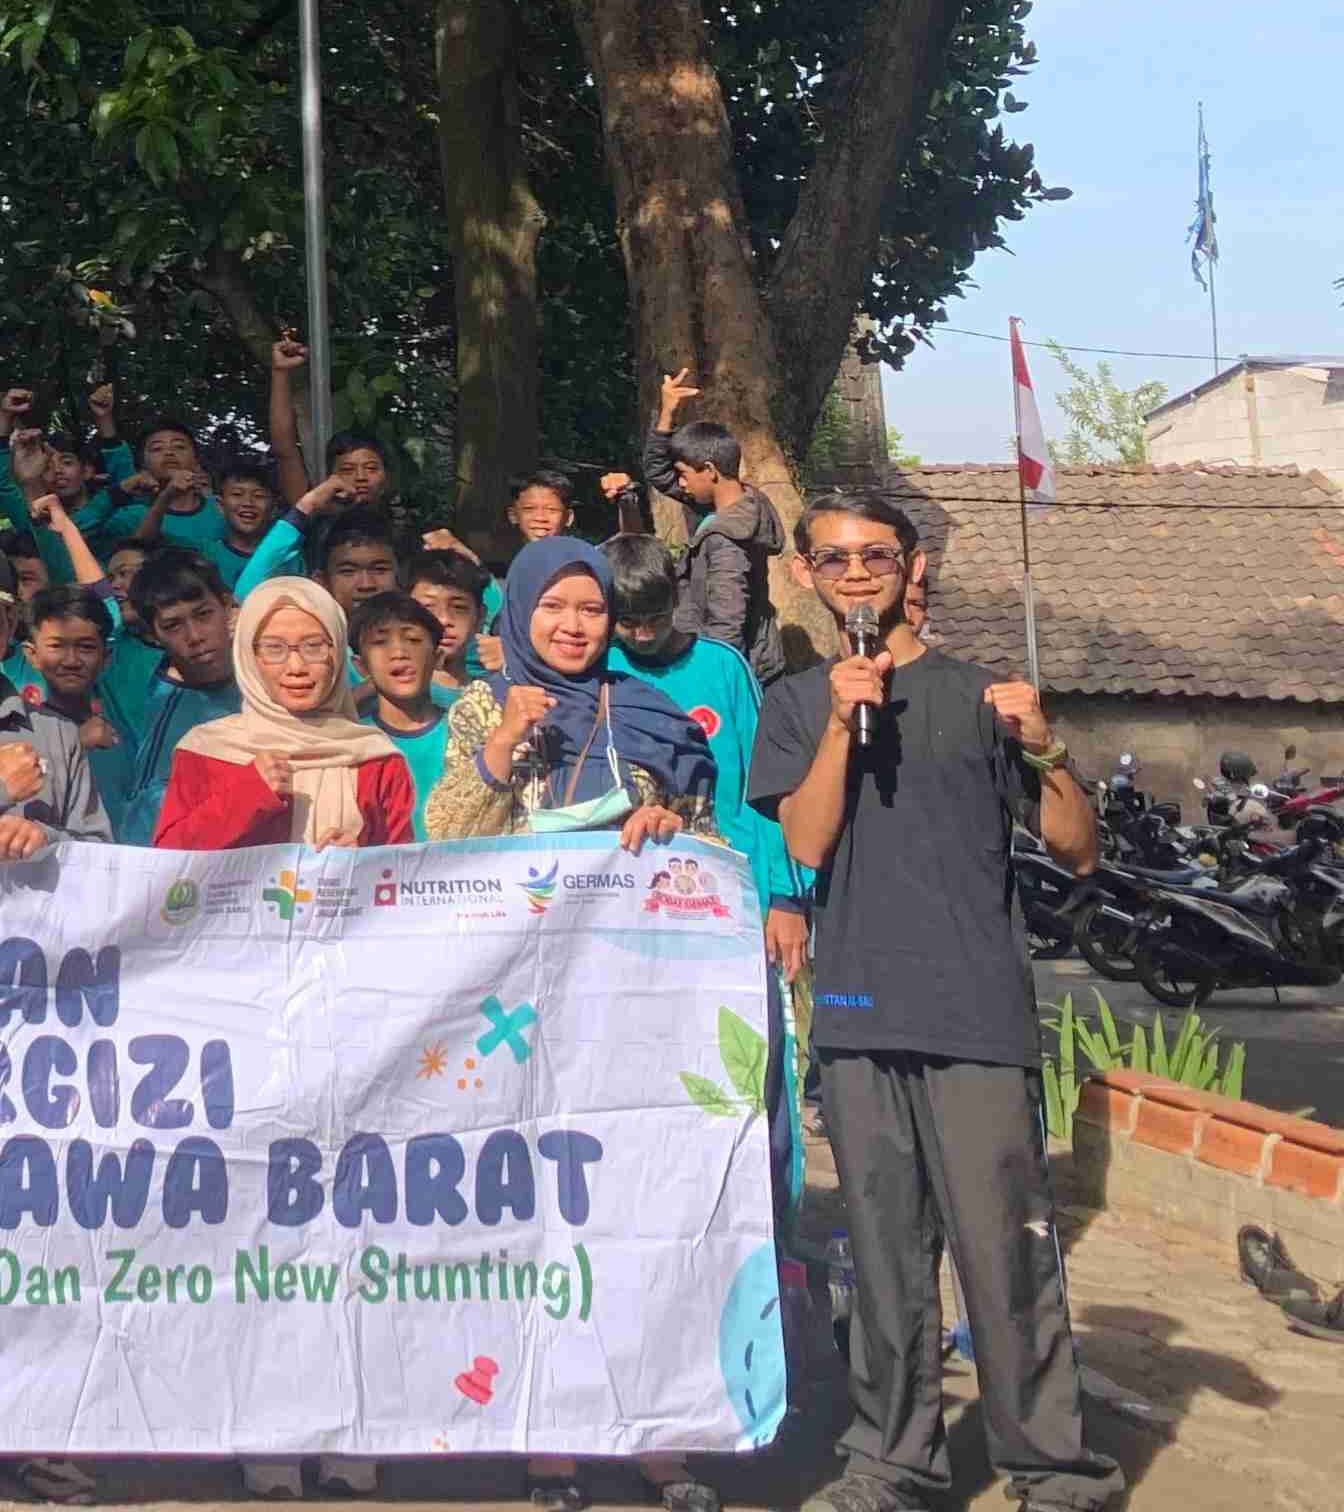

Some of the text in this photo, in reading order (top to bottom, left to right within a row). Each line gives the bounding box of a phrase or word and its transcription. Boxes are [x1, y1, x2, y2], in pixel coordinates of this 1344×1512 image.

[400, 879, 503, 895] NUTRITION
[563, 874, 635, 889] GERMAS
[266, 1130, 603, 1229] BARAT
[103, 1248, 214, 1305] Zero
[233, 1248, 339, 1305] New
[357, 1242, 595, 1322] Stunting)
